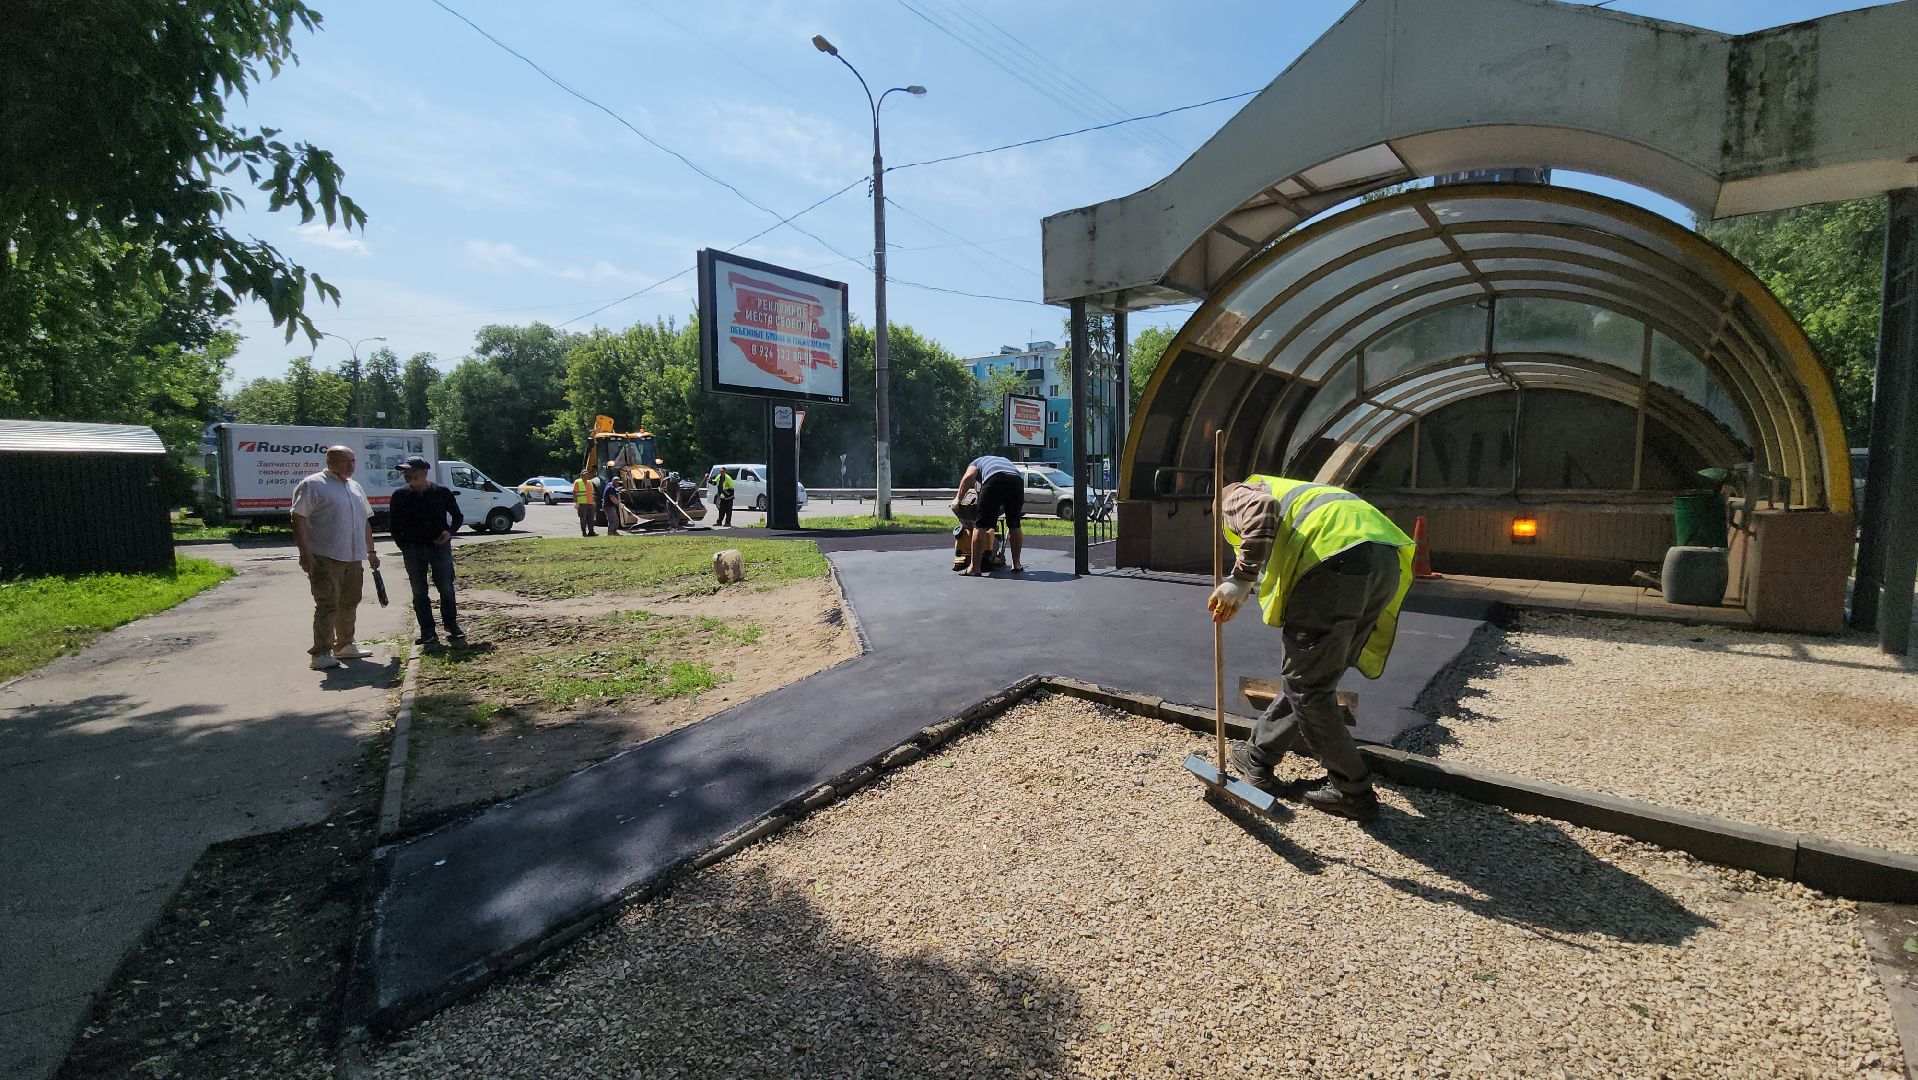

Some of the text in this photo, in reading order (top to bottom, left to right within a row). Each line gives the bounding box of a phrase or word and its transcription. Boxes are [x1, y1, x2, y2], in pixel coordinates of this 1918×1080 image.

[257, 460, 320, 468] Запчасти для
[266, 478, 288, 487] (495)
